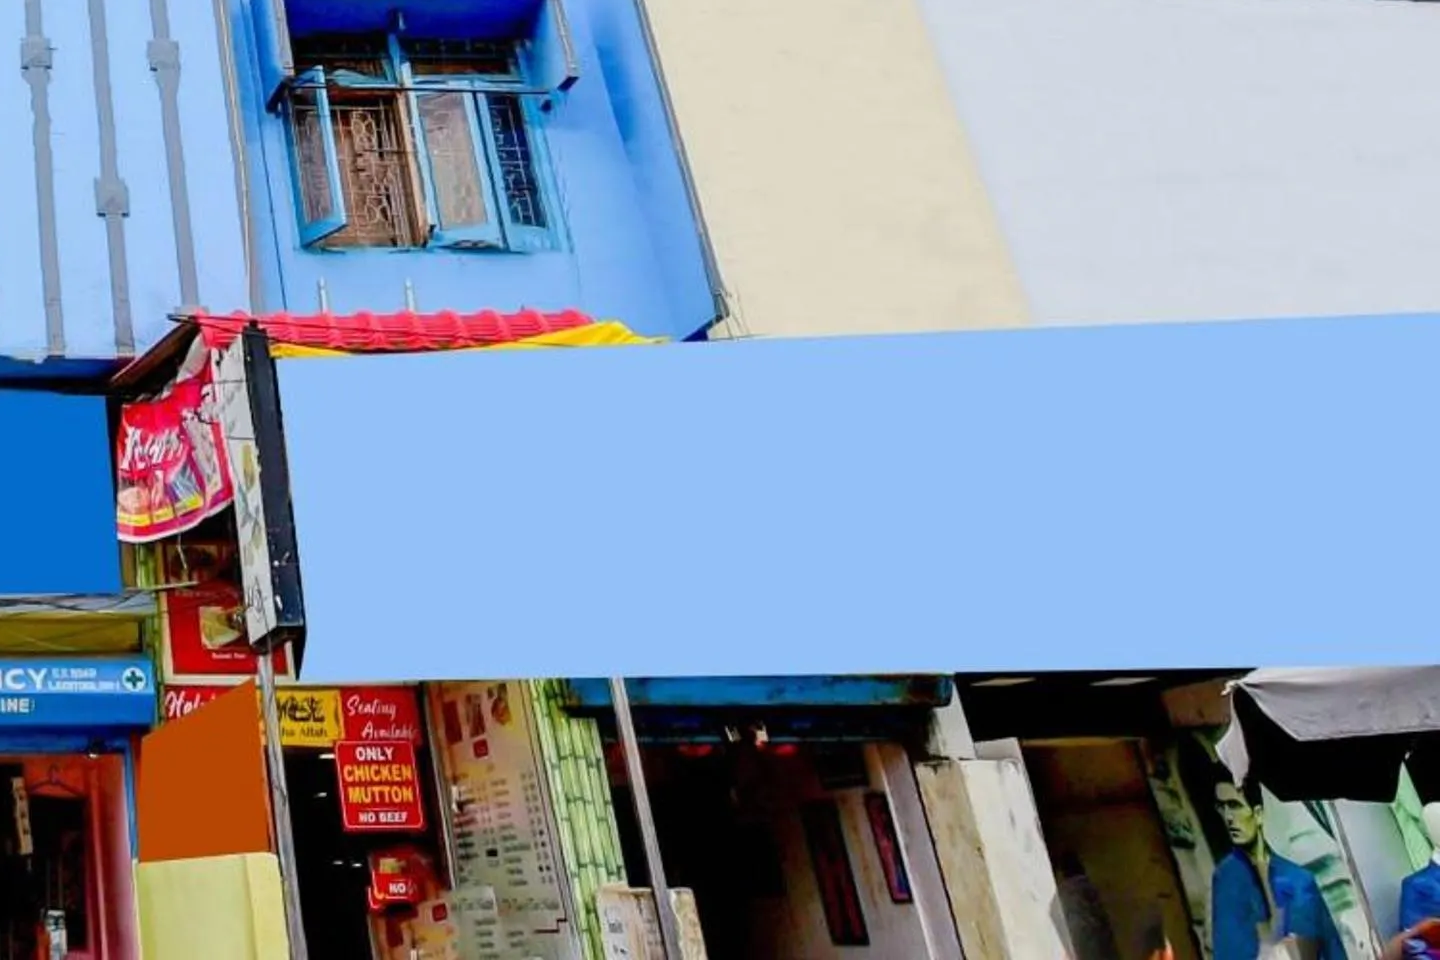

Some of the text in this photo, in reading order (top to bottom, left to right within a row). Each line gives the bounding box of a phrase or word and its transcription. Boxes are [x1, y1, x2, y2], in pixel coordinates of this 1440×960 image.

[346, 695, 397, 719] Seating
[355, 746, 395, 761] ONLY
[343, 763, 413, 783] CHICKEN
[348, 786, 414, 804] MUTTON
[358, 812, 408, 823] NO BEEF
[388, 882, 407, 894] NO
